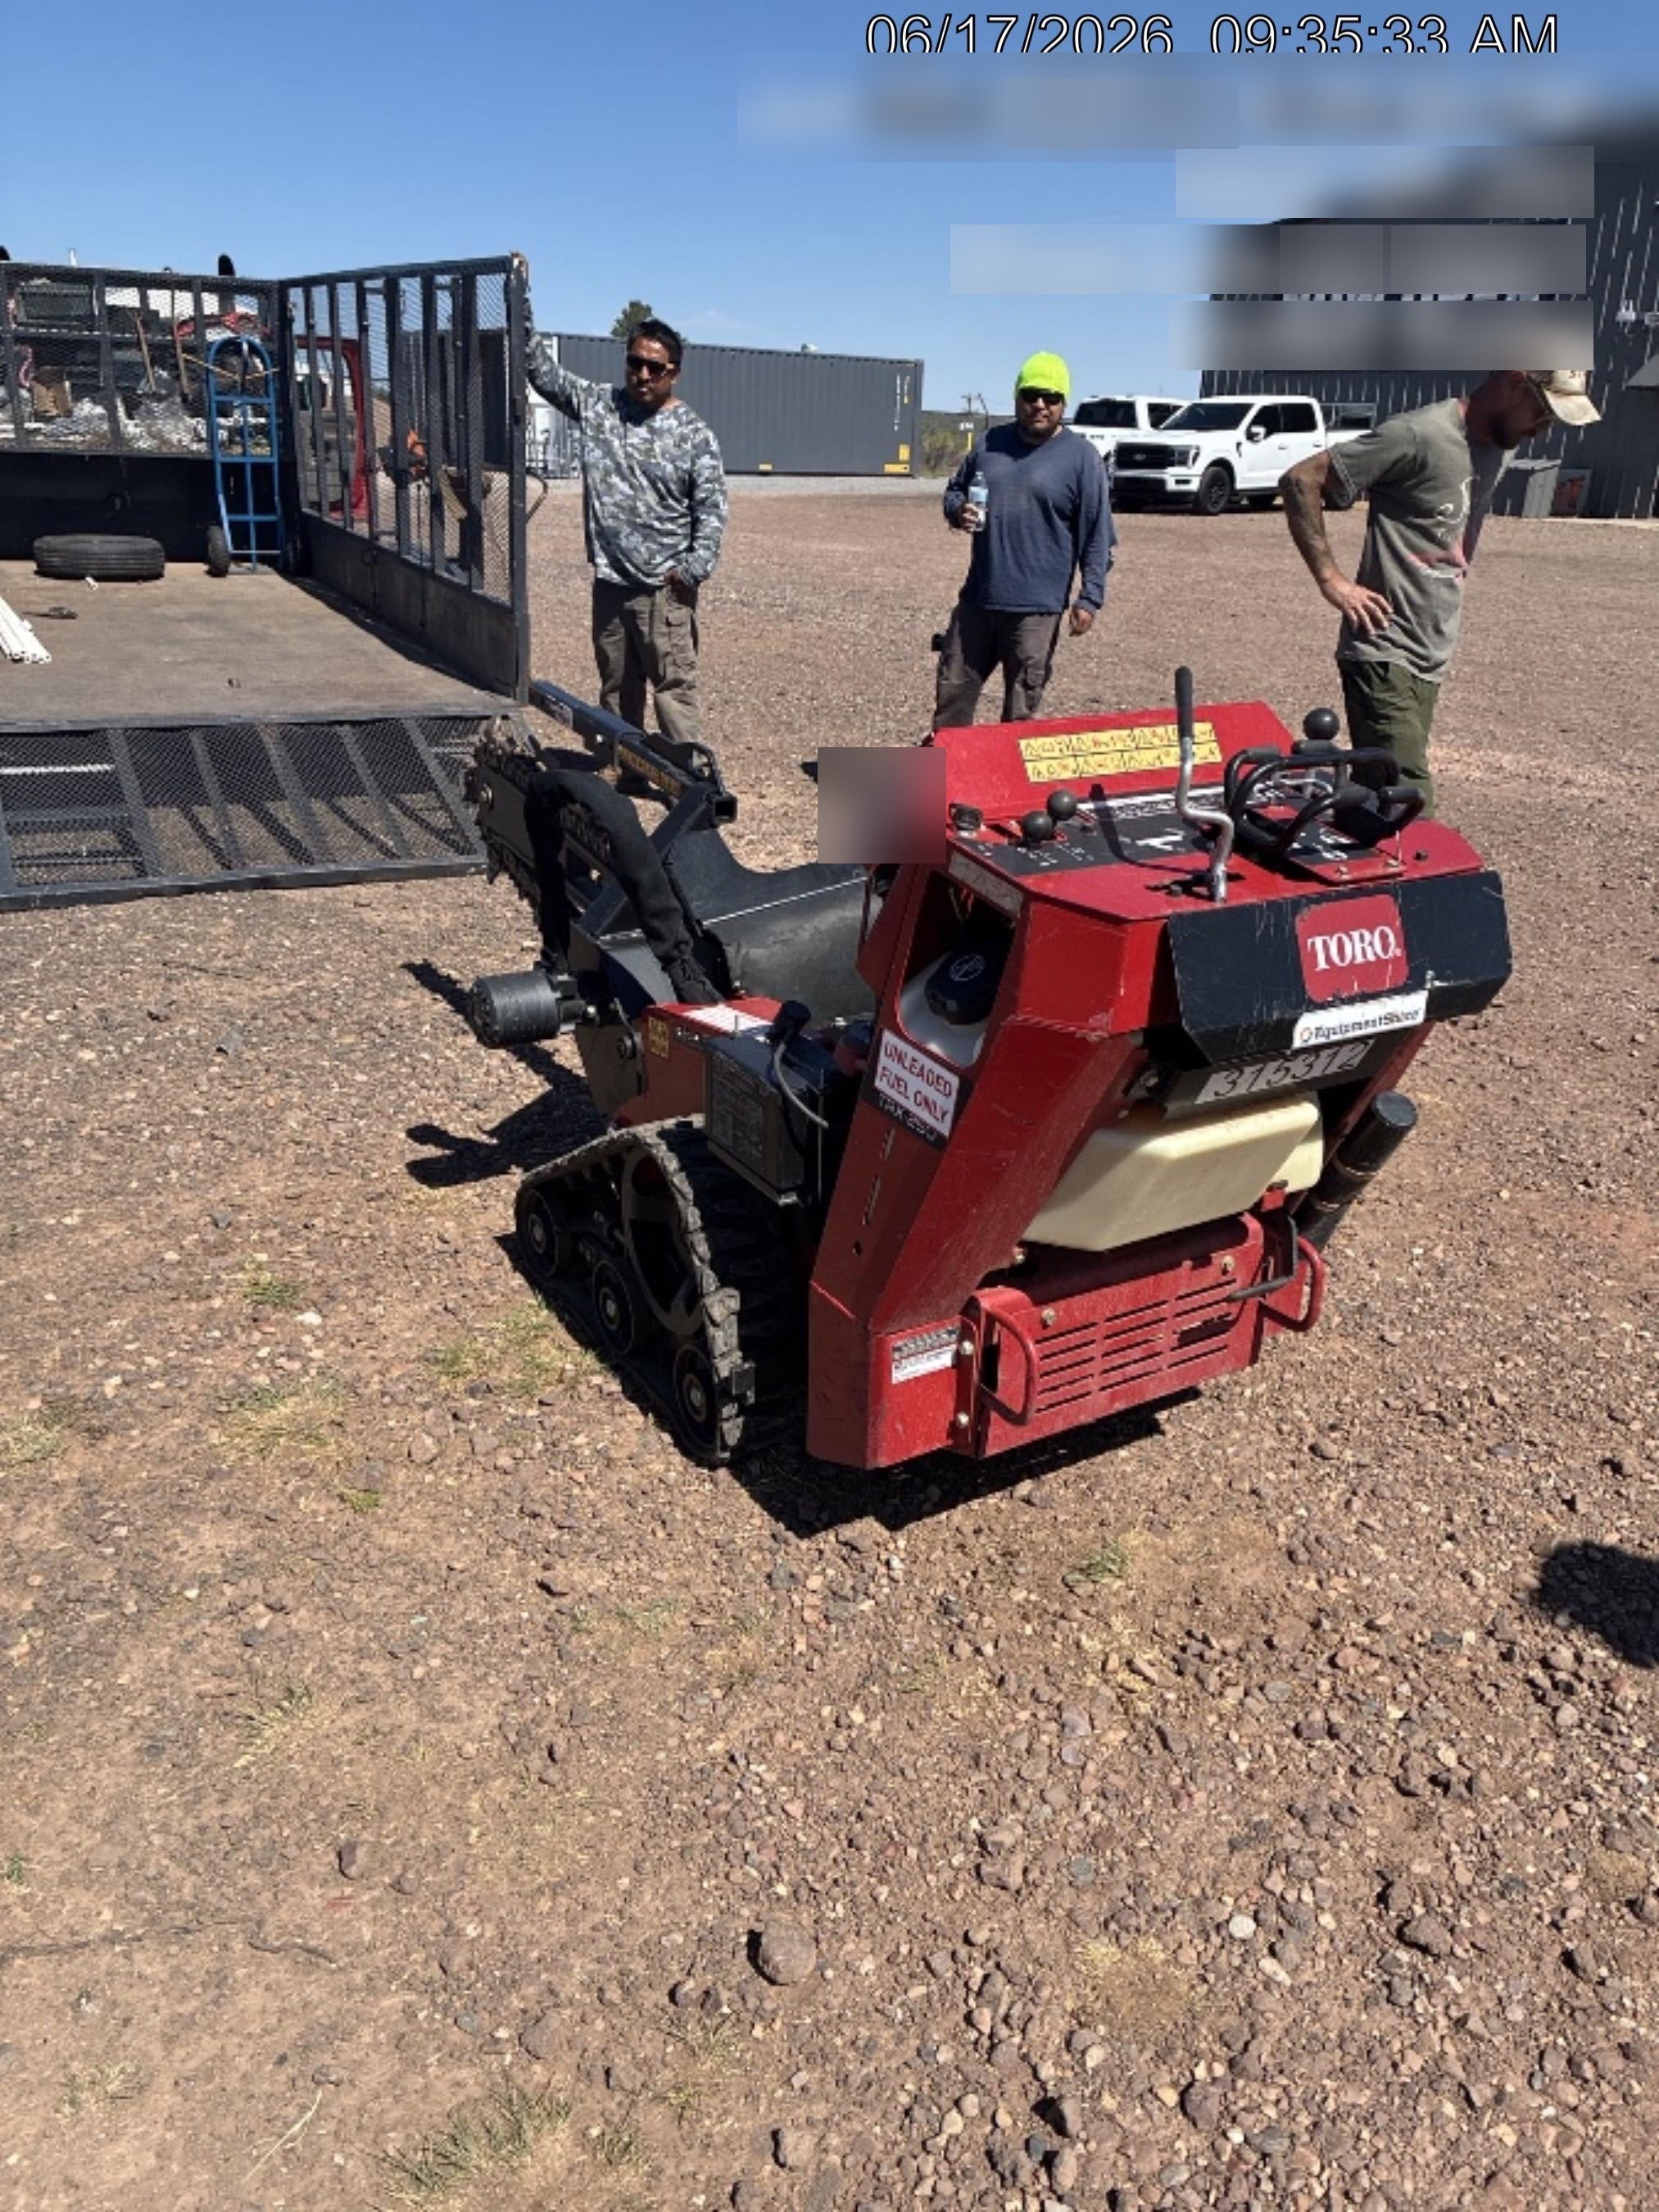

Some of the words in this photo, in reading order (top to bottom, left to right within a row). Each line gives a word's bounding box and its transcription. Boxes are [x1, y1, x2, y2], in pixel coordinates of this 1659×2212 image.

[1308, 925, 1395, 972] TORO
[879, 1066, 909, 1101] FUEL
[913, 1088, 950, 1123] ONLY
[884, 1041, 952, 1099] UNLEADED
